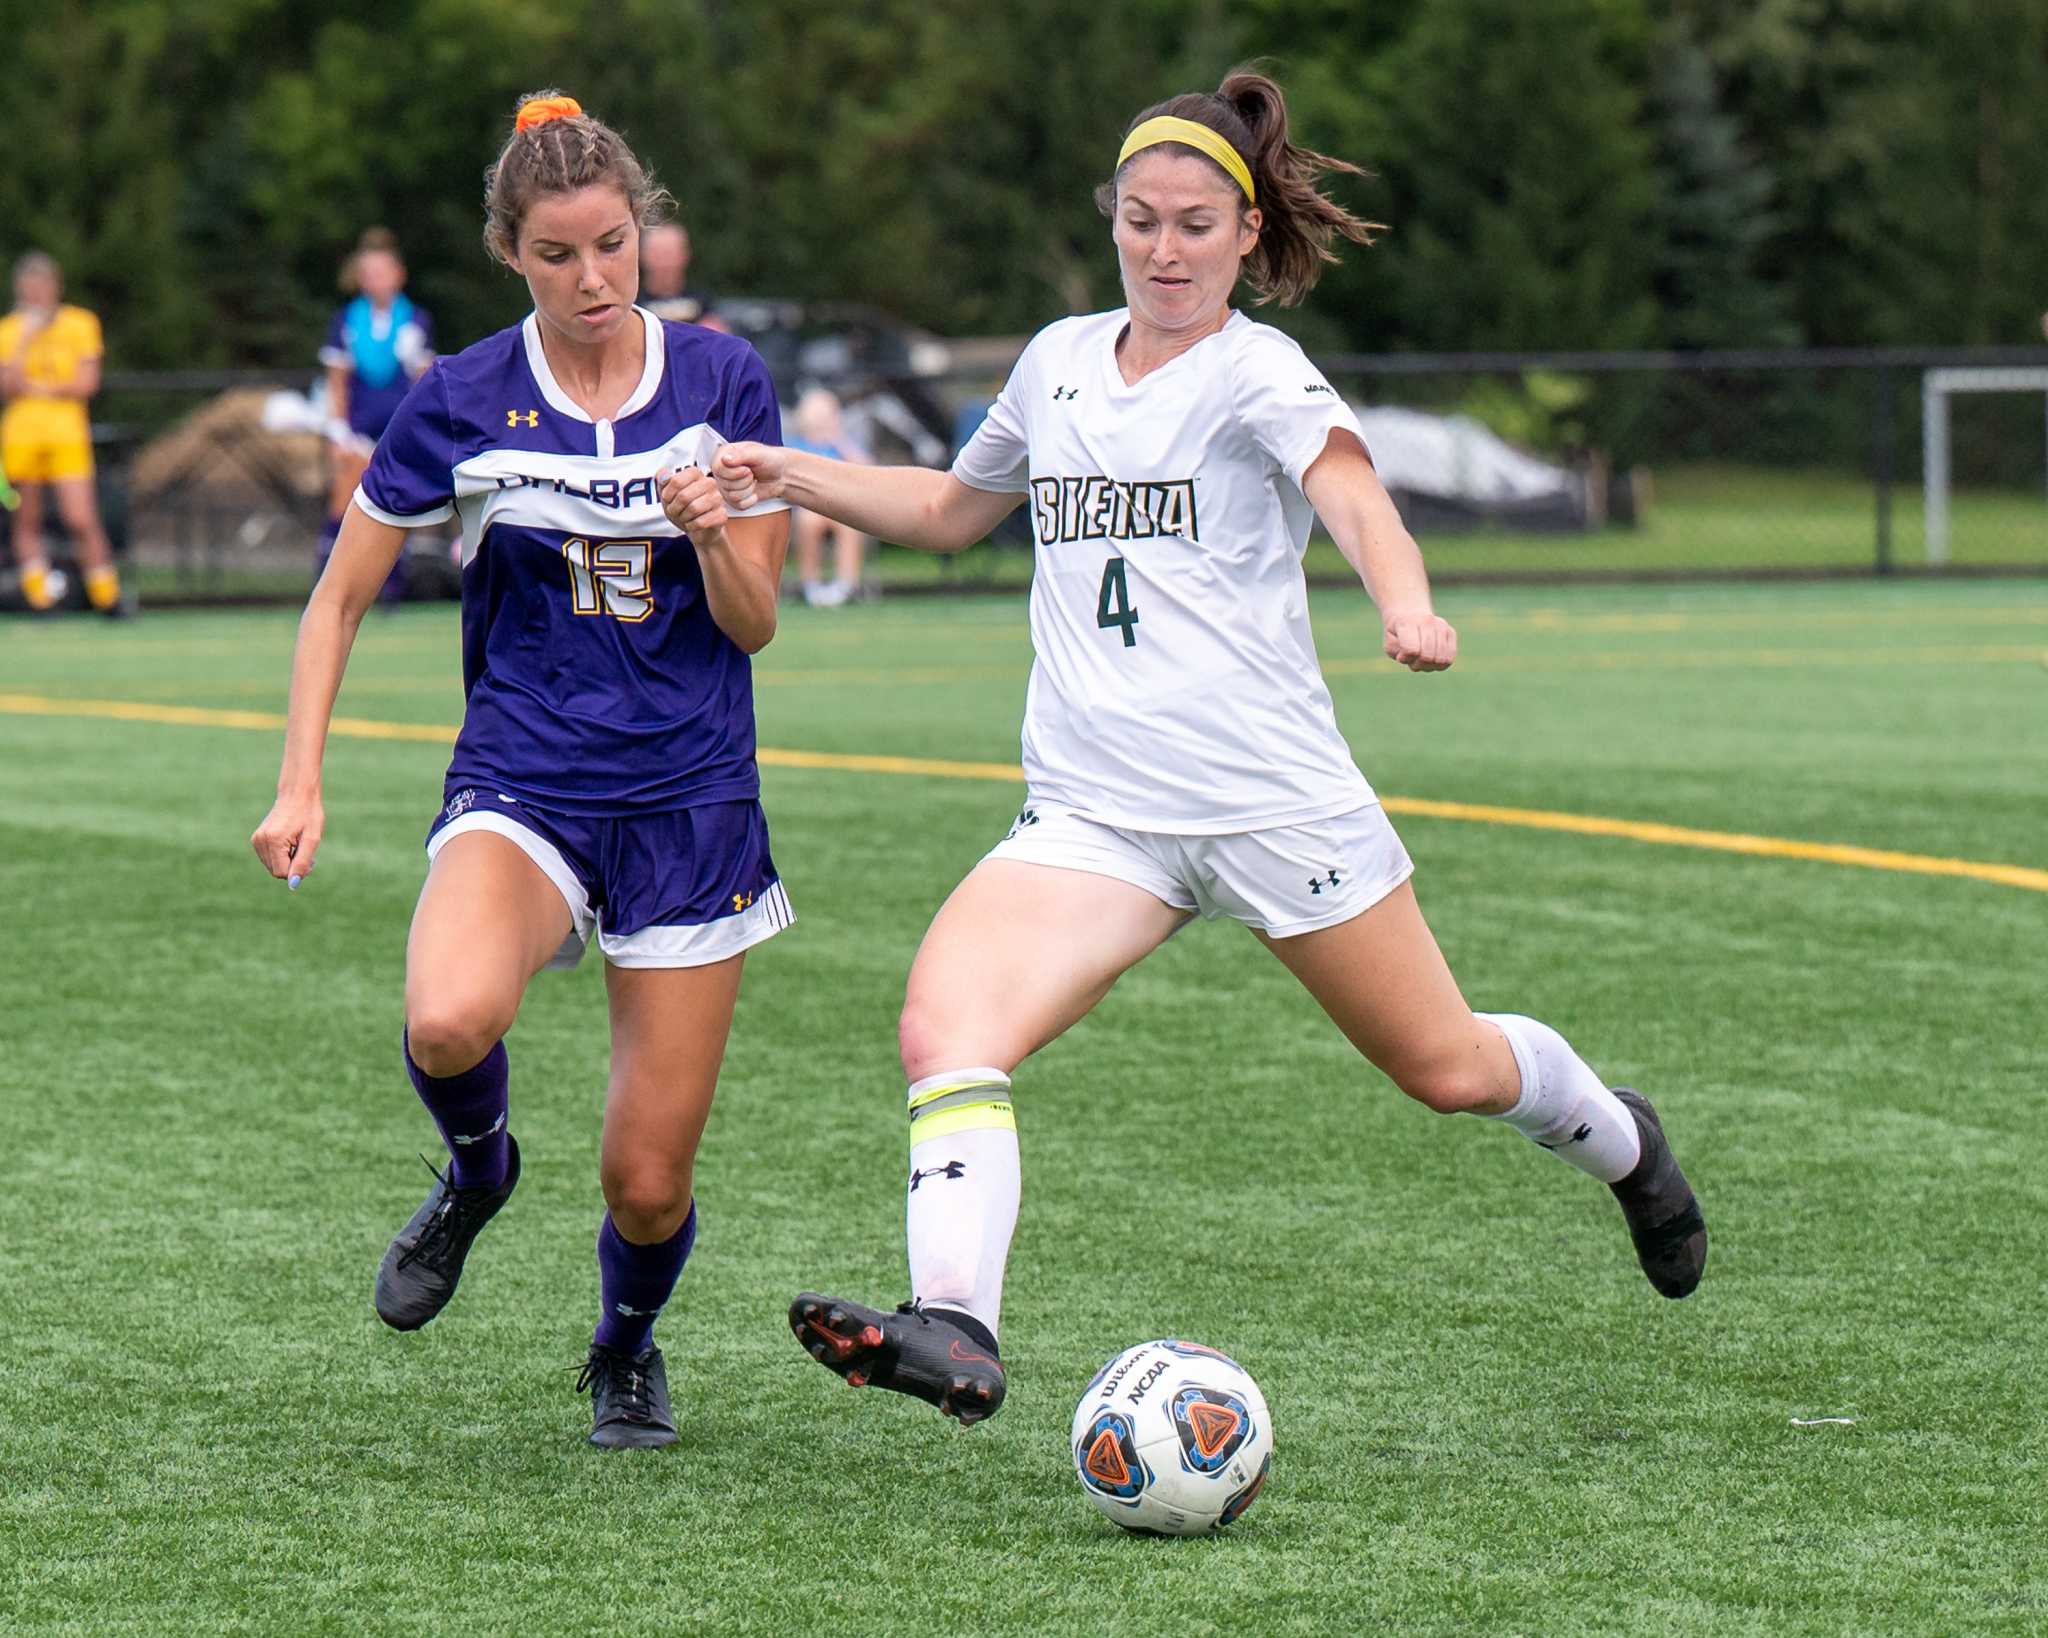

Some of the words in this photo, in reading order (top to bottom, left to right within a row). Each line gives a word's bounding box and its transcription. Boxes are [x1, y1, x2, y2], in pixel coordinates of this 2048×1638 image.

[1030, 476, 1198, 546] SIENA
[562, 537, 654, 623] 12
[1097, 557, 1139, 648] 4
[1101, 1350, 1149, 1398] Wilson
[1127, 1360, 1170, 1405] NCAA
